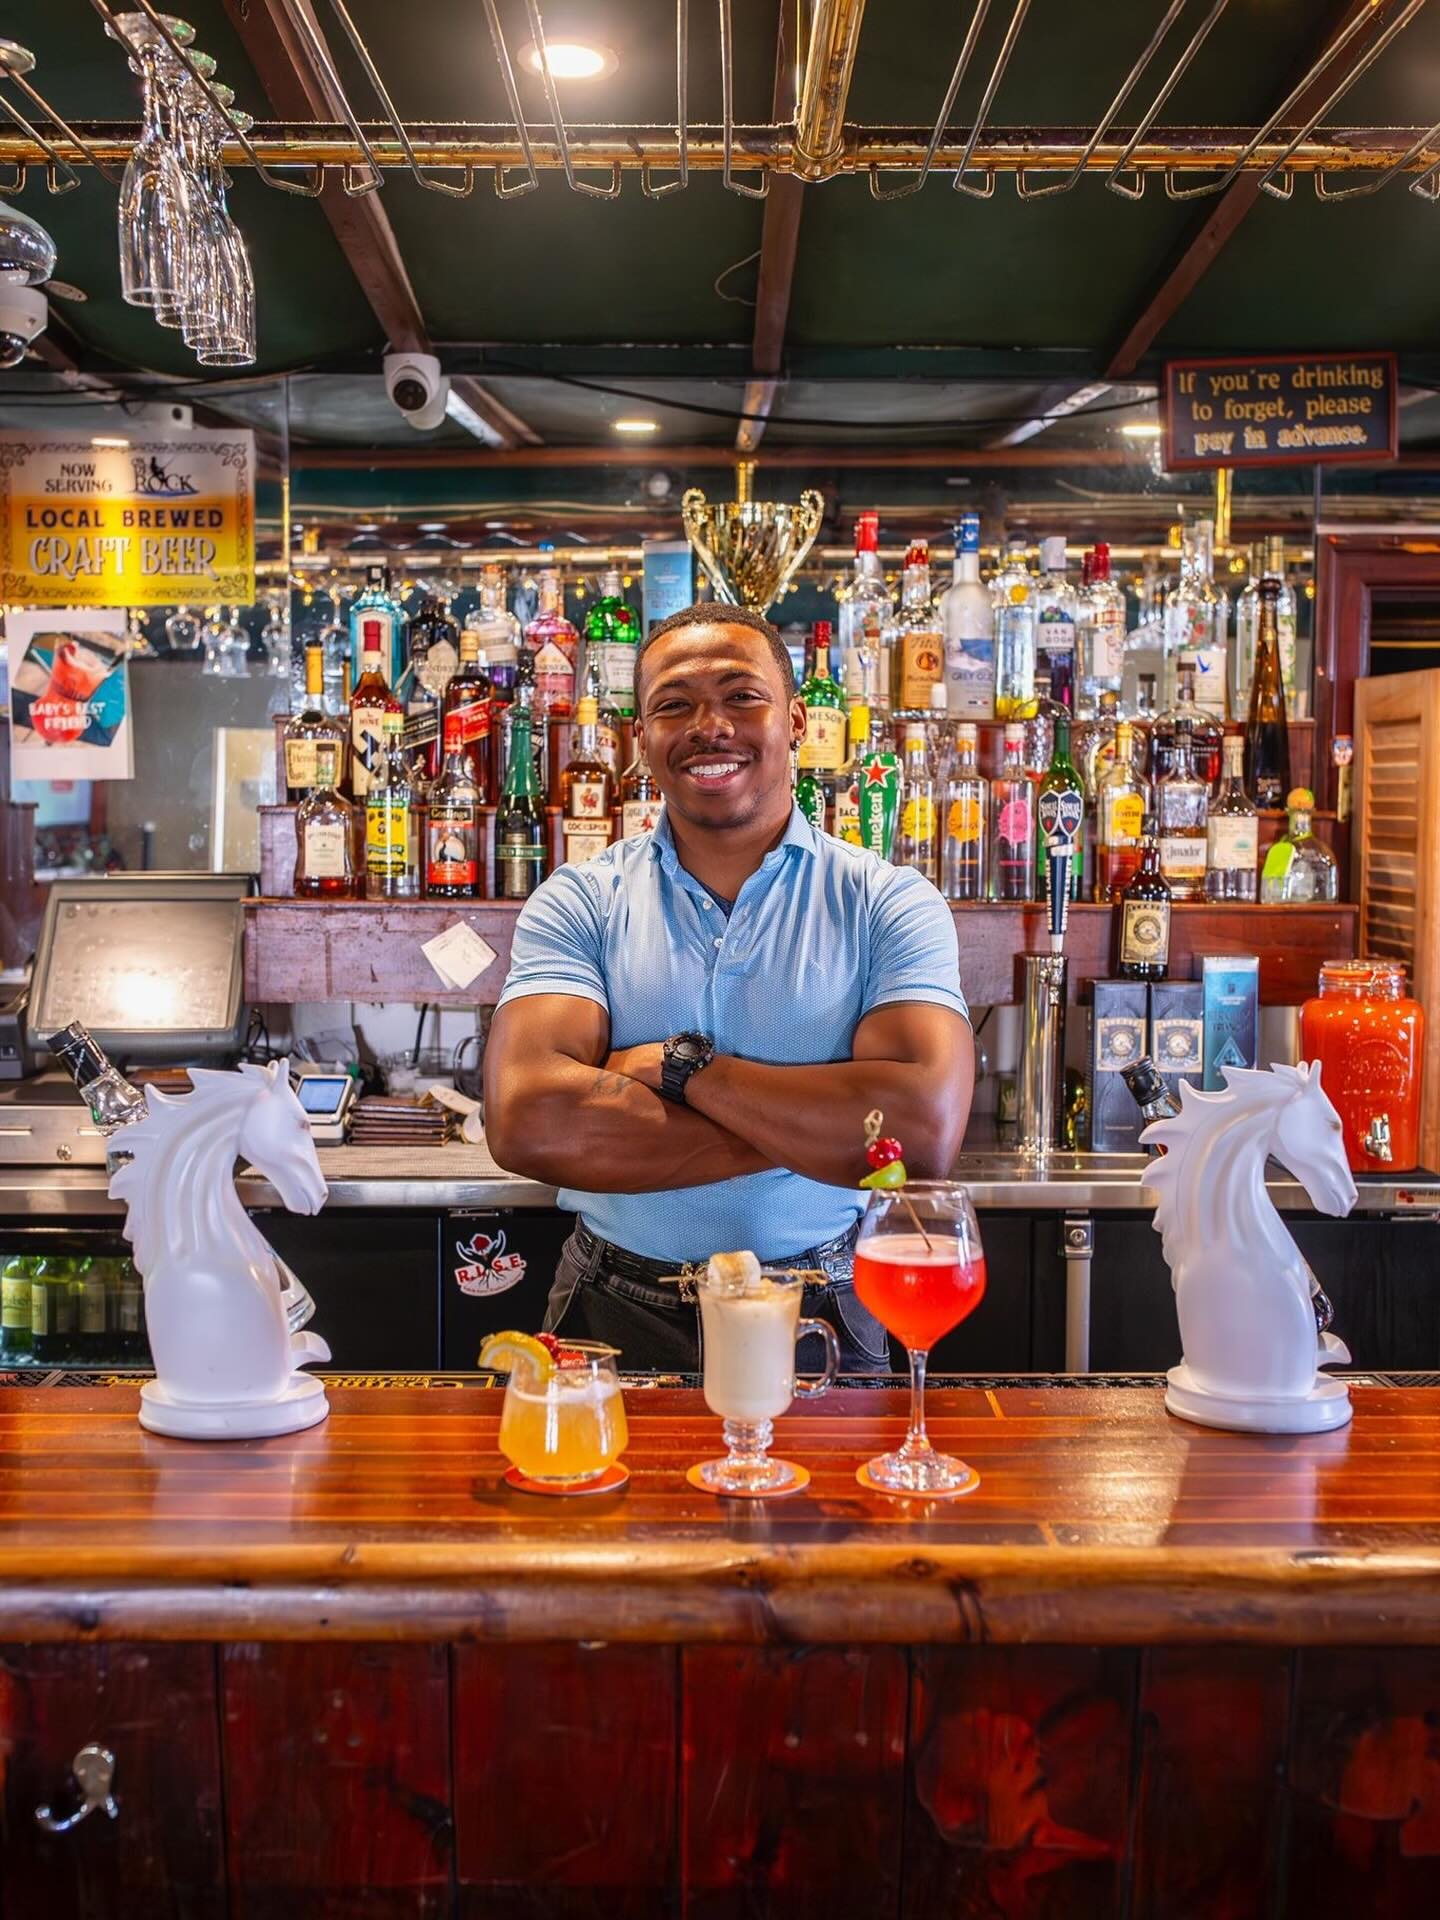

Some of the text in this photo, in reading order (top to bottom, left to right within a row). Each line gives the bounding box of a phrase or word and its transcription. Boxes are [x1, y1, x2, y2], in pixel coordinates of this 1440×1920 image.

[1179, 364, 1384, 395] If you're drinking
[1191, 394, 1372, 422] to forget, please
[1194, 424, 1368, 456] pay in advance.
[60, 463, 95, 478] NOW
[45, 478, 113, 493] SERVING
[134, 472, 199, 494] ROCK
[26, 507, 224, 528] LOCAL BREWED
[30, 537, 220, 581] CRAFT BEER
[808, 711, 842, 724] MESON
